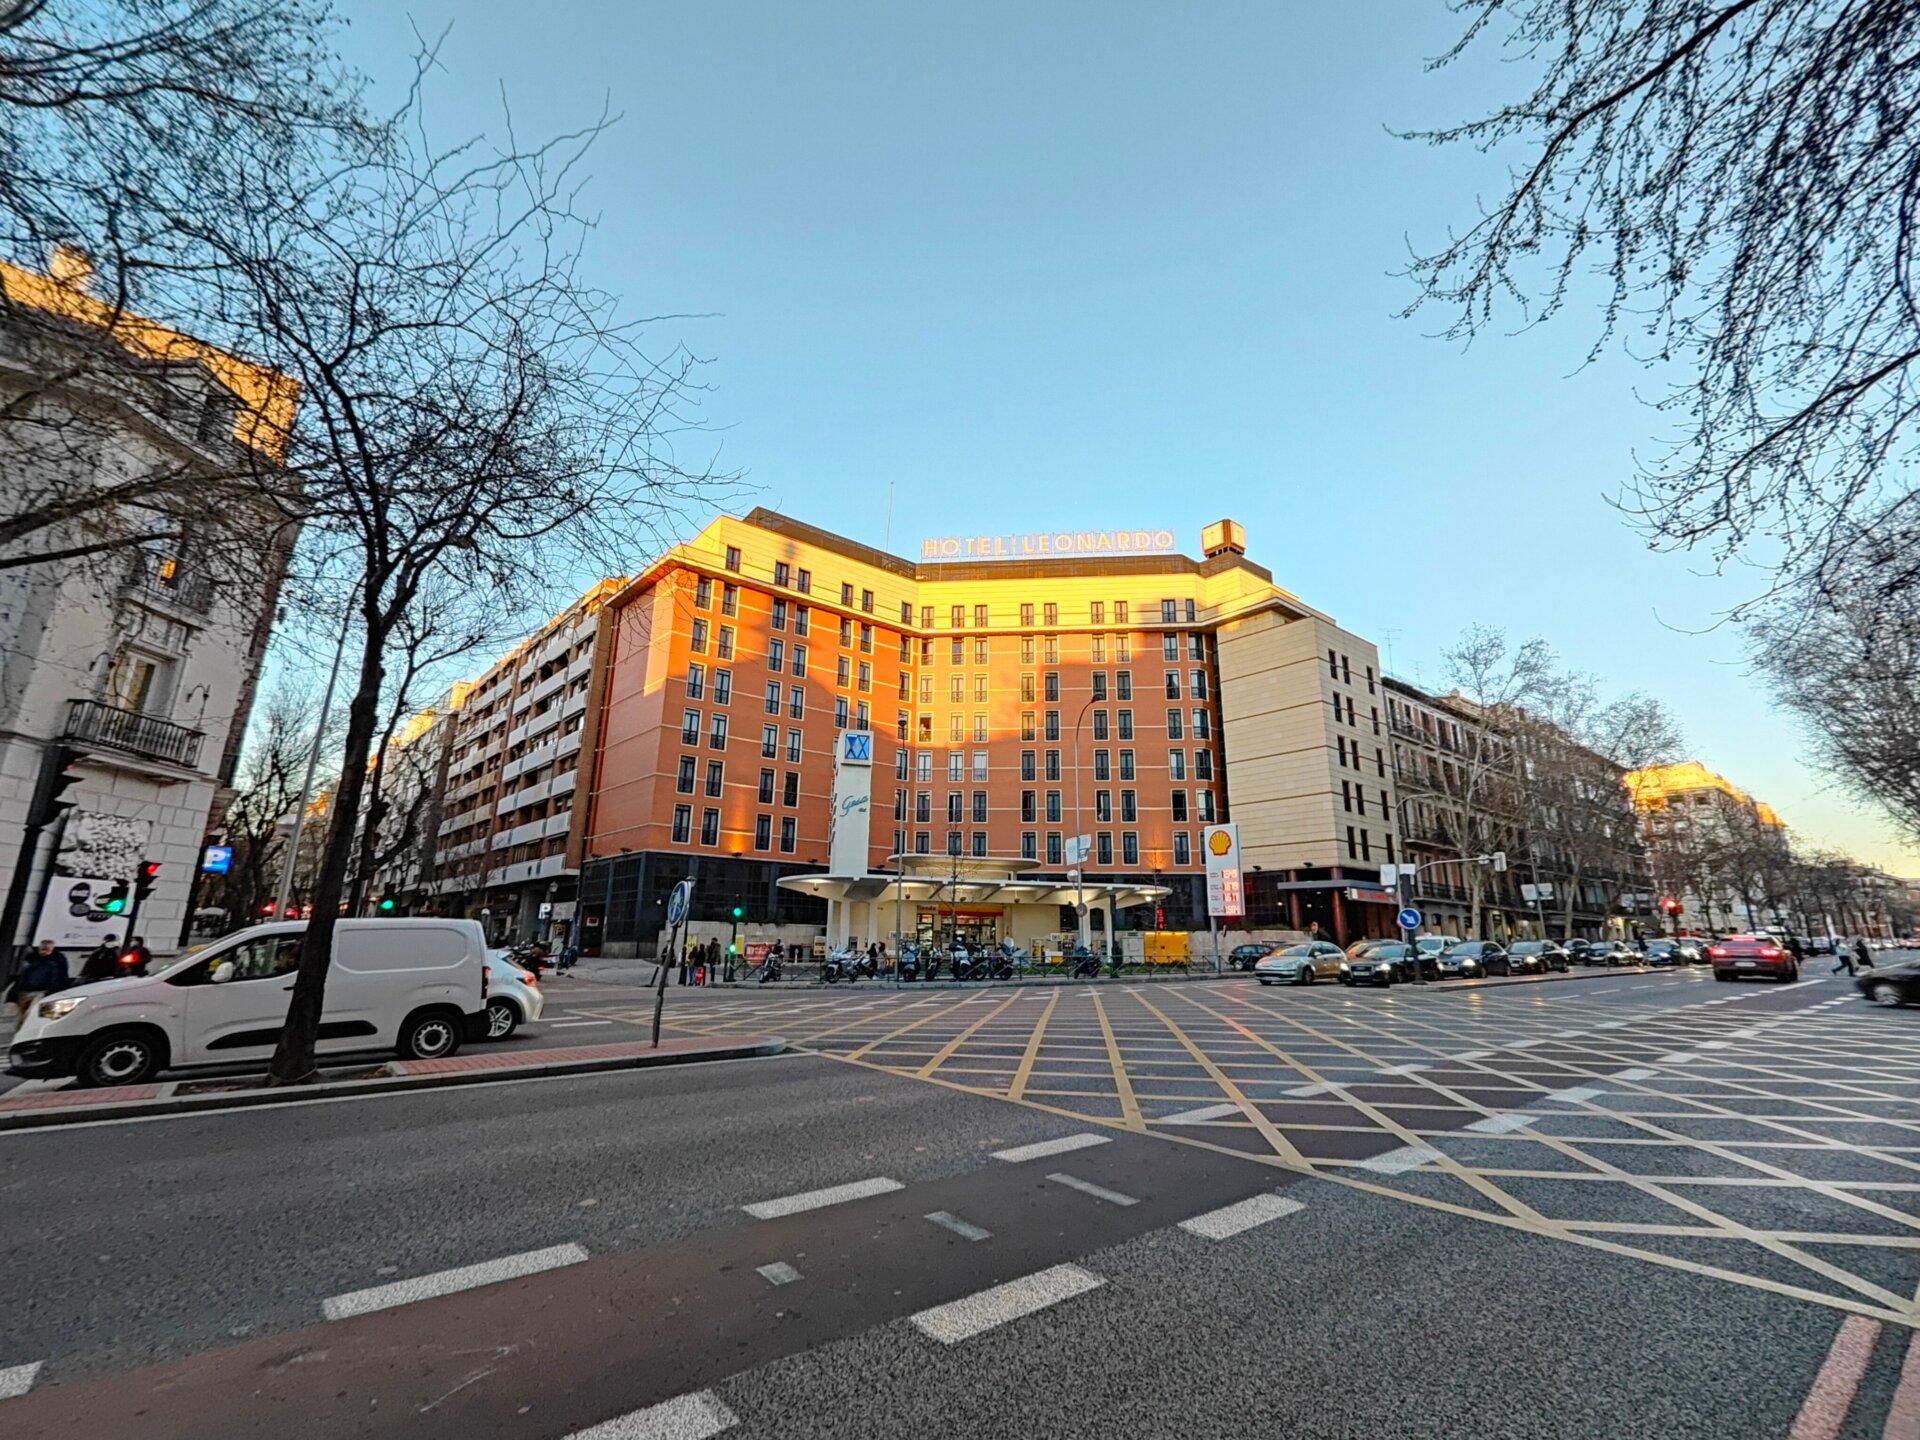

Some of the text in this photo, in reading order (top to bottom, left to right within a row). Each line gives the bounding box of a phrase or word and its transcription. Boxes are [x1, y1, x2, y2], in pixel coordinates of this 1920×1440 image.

[924, 531, 1173, 556] HOTEL LEONARDO
[202, 849, 226, 867] P
